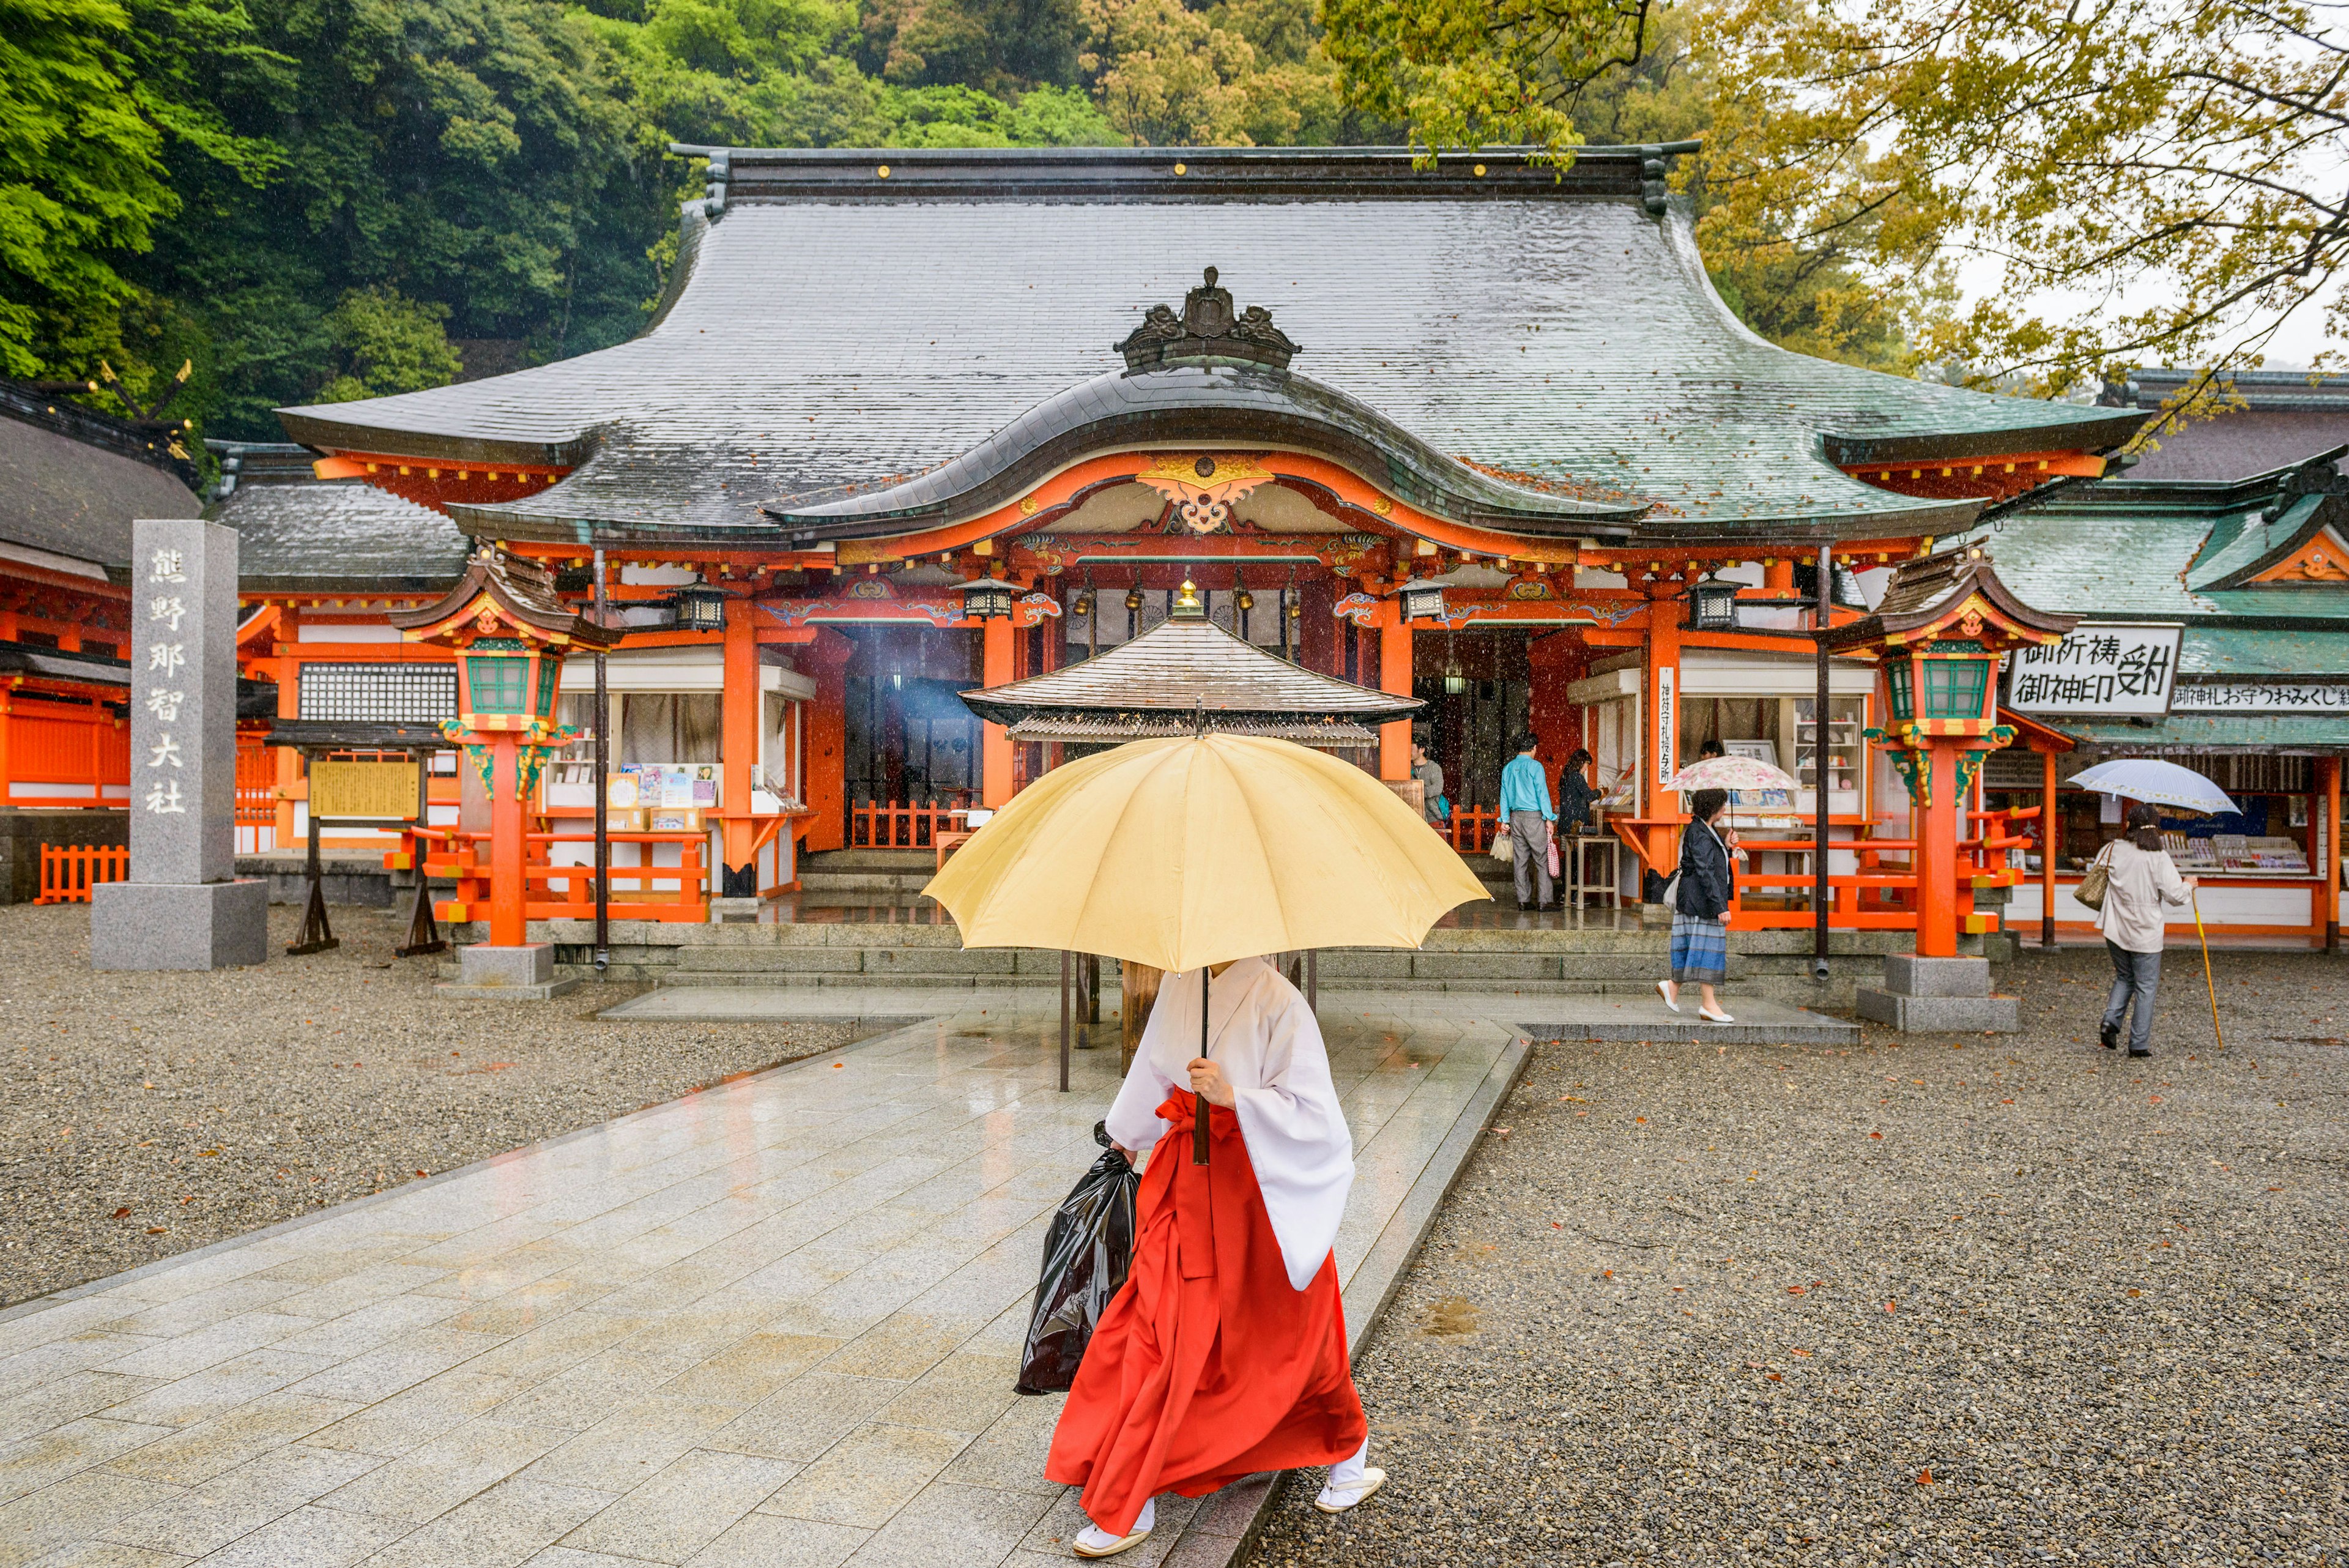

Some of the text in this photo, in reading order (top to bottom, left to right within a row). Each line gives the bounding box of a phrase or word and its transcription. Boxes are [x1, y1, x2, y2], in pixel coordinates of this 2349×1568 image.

[2022, 634, 2120, 665] 御祈祷
[2115, 643, 2170, 696] 受付
[146, 549, 186, 814] 熊野那智大社
[2014, 673, 2115, 704] 御神印
